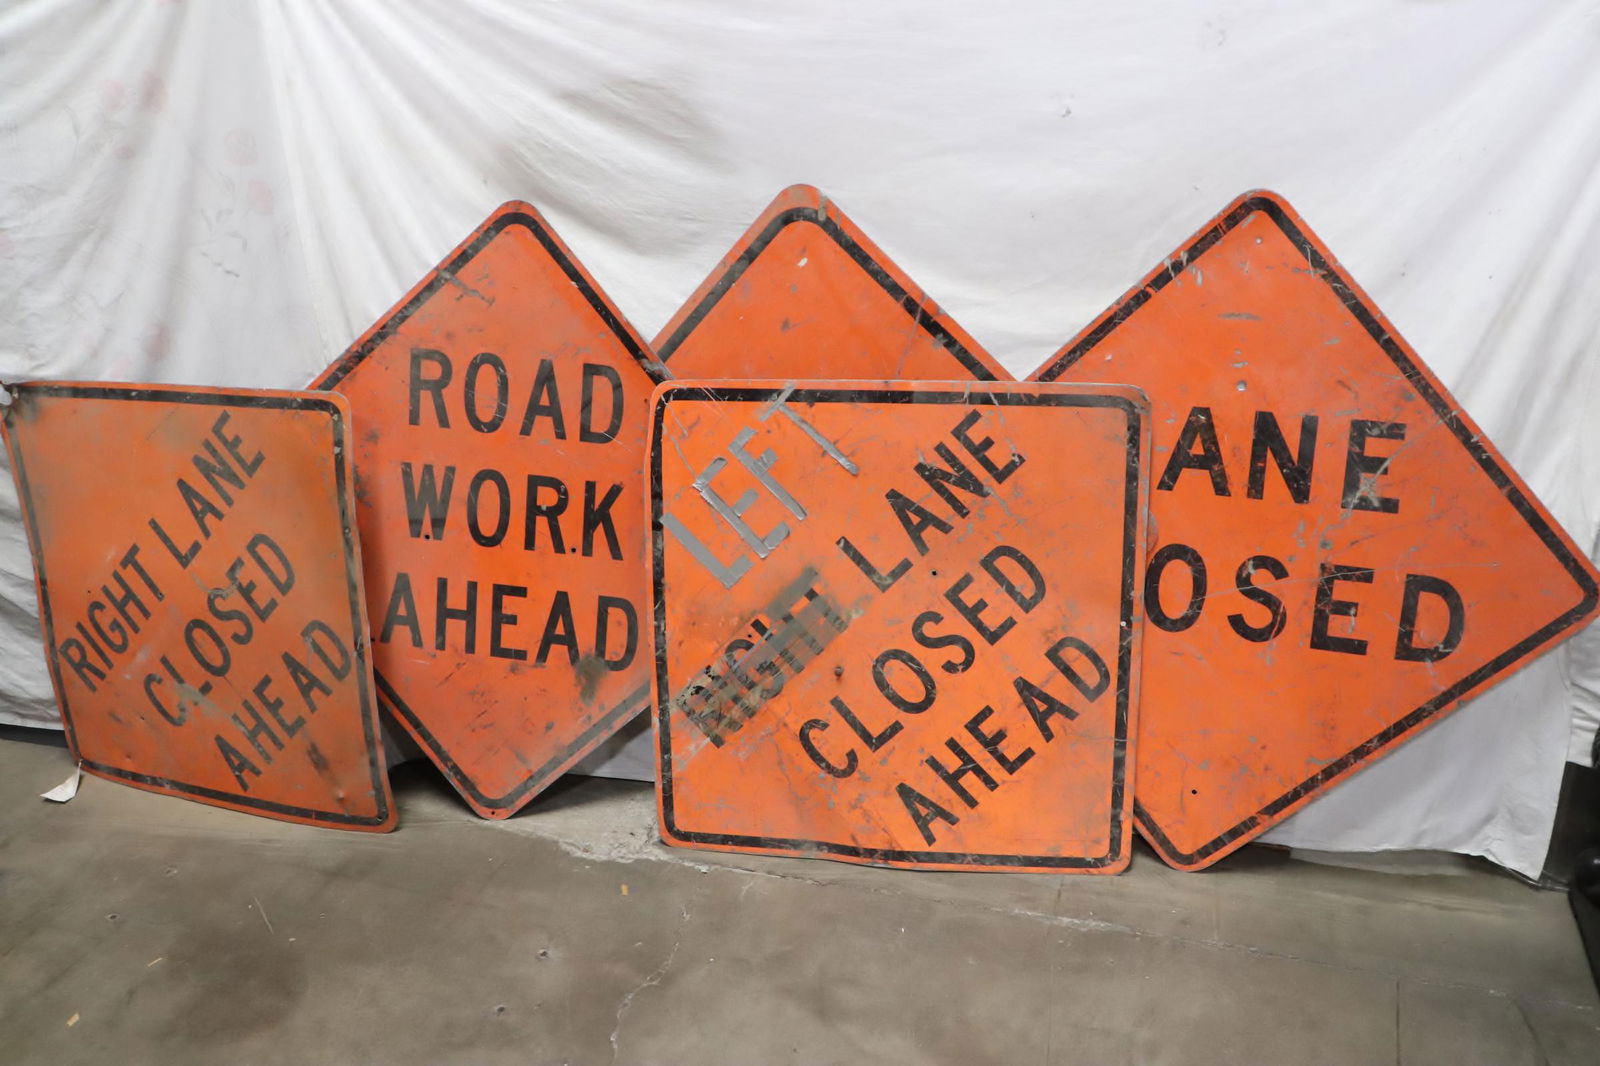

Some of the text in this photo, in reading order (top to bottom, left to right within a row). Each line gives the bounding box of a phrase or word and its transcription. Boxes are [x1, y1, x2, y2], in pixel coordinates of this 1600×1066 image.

[408, 348, 624, 444] ROAD
[1156, 406, 1407, 514] ANE
[59, 410, 265, 693] RIGHT LANE
[401, 461, 625, 562] WORK
[660, 384, 859, 590] LEFT
[836, 409, 1026, 592] LANE
[143, 533, 296, 727] CLOSED
[380, 572, 639, 672] AHEAD
[799, 545, 1046, 779] CLOSED
[1144, 543, 1465, 663] OSED
[213, 620, 352, 792] AHEAD
[895, 636, 1111, 847] AHEAD
